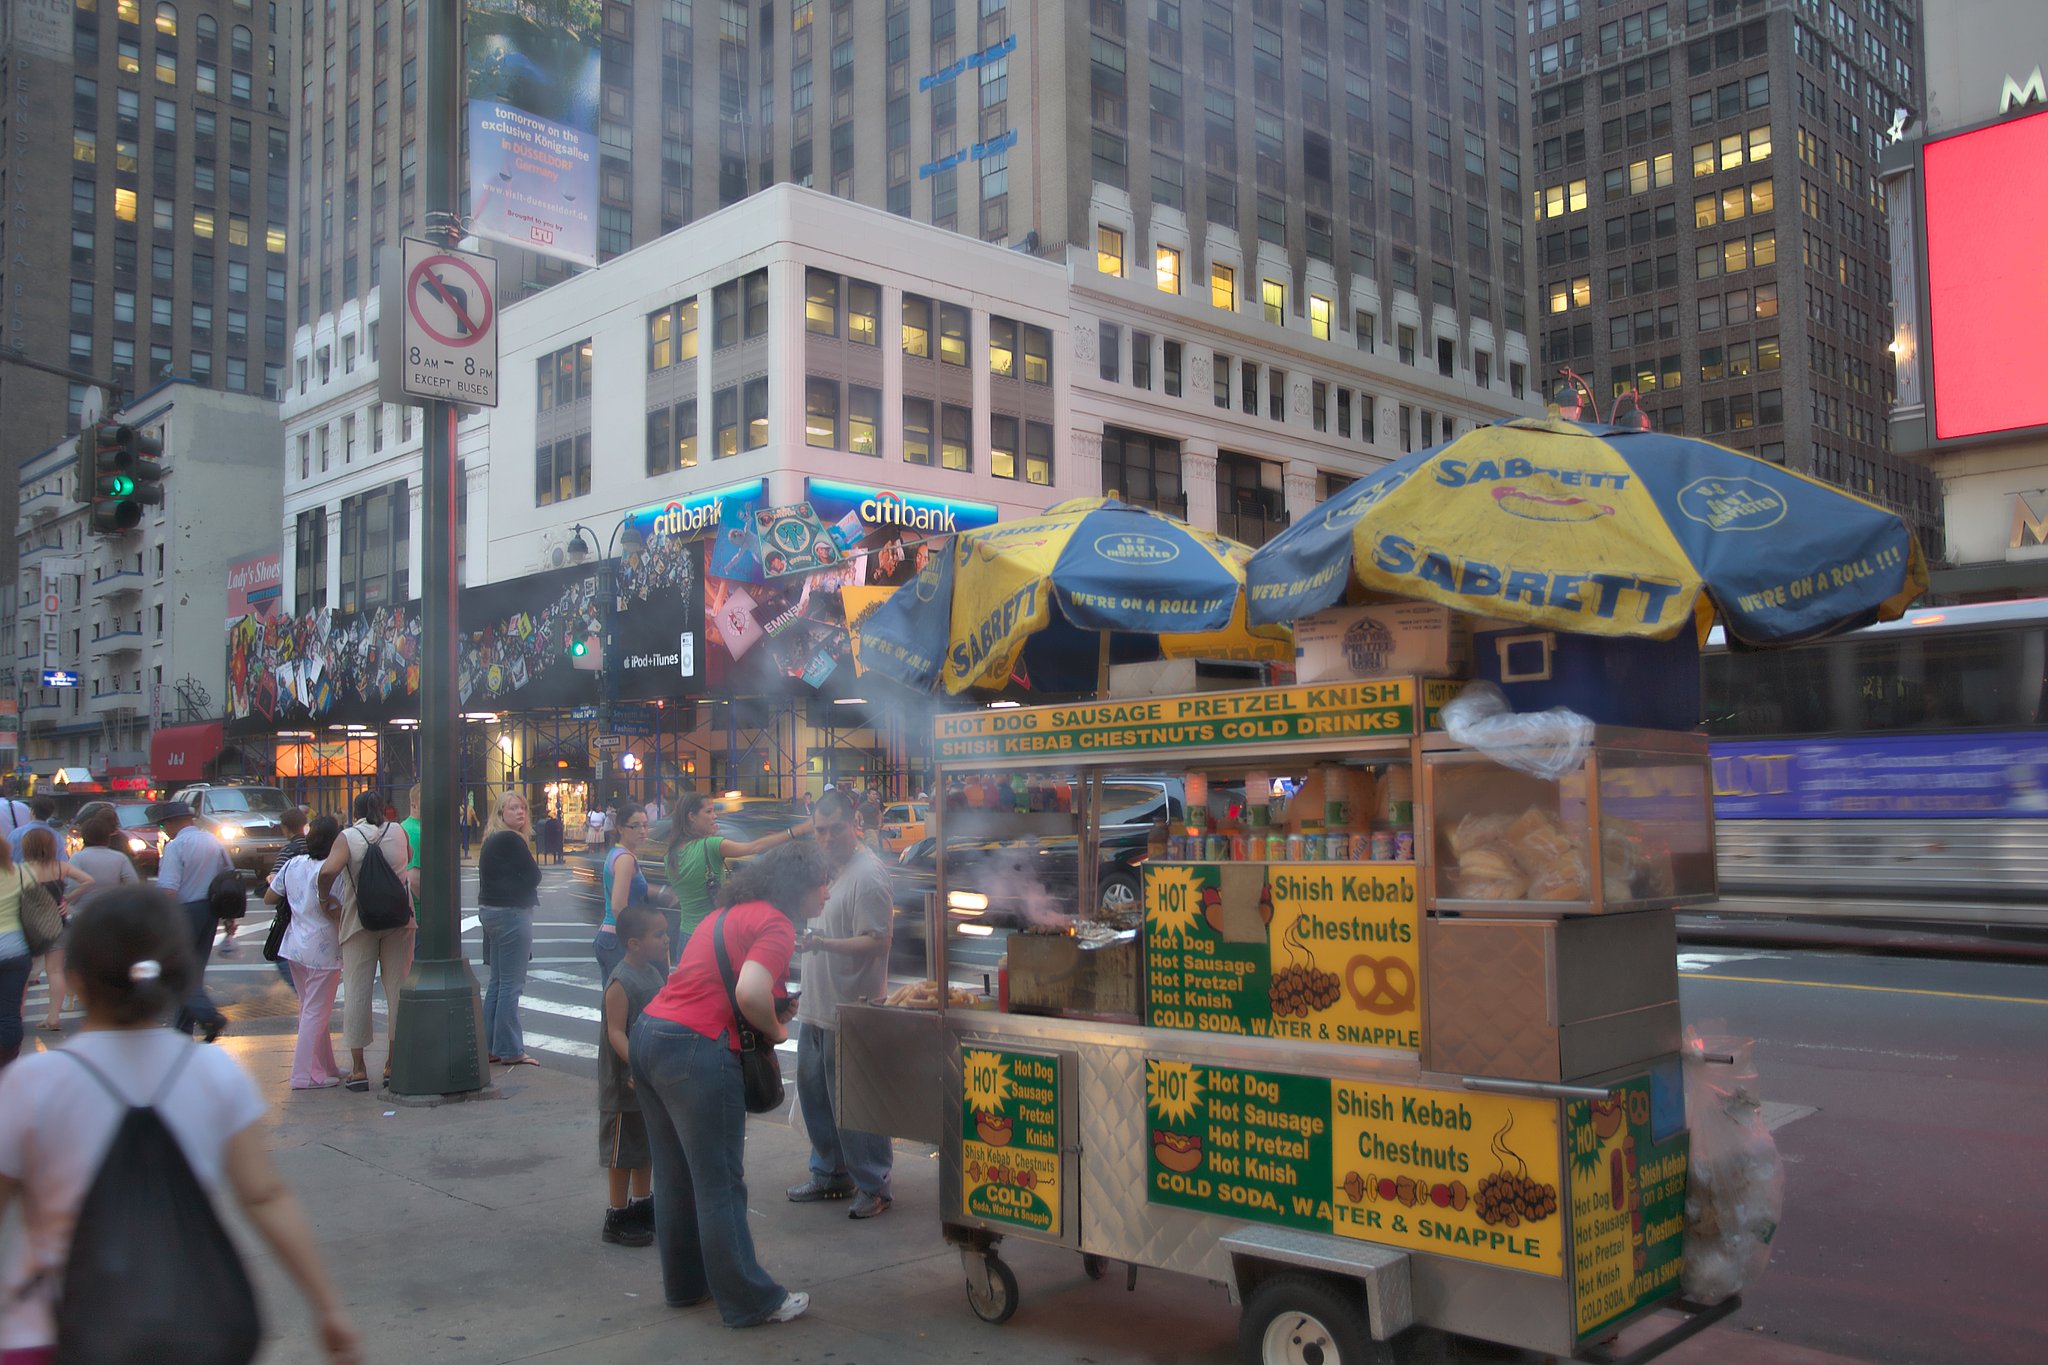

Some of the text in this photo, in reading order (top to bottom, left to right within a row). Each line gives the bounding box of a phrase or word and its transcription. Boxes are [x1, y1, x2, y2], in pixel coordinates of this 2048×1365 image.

[481, 119, 590, 161] exclusive Königsallee
[495, 107, 579, 144] tomorrow on the
[14, 58, 30, 266] PENNSYLVANIA
[513, 141, 574, 172] DÜSSELDORF
[515, 158, 559, 182] Germany
[507, 209, 535, 223] Brought
[535, 216, 542, 225] to
[531, 226, 554, 245] LTU
[409, 346, 421, 366] 8
[423, 358, 439, 369] AM
[464, 356, 475, 376] 8
[479, 368, 493, 380] PM
[414, 373, 489, 396] EXCEPT BUSES
[1430, 456, 1631, 491] SABRETT
[653, 496, 724, 537] citibank
[860, 493, 956, 533] citibank
[1707, 497, 1779, 527] INSPECTED
[1106, 550, 1171, 559] INSPECTED
[227, 560, 281, 593] Lady's Shoes
[1251, 582, 1288, 600] WE'RE
[1371, 529, 1682, 625] SABRETT
[1736, 546, 1902, 615] WE'RE ON A ROLL !!!
[1071, 590, 1223, 614] WE'RE ON A ROLL !!!
[43, 576, 59, 669] HOTEL
[950, 577, 1041, 679] SABRETT
[862, 634, 893, 655] WE'RE
[630, 652, 679, 668] iPod+iTunes
[1429, 683, 1446, 702] HOT
[944, 684, 1400, 735] HOT DOG SAUSAGE PRETZEL KNISH
[614, 724, 637, 733] Fashion
[941, 712, 1401, 757] SHISH KEBAB CHESTNUTS COLD DRINKS
[167, 751, 186, 766] J&J
[1158, 884, 1188, 913] HOT
[1274, 875, 1415, 904] Shish Kebab
[1297, 913, 1412, 943] Chestnuts
[1150, 934, 1215, 955] Hot Dog
[1150, 952, 1256, 975] Hot Sausage
[1151, 970, 1244, 992] Hot Pretzel
[1151, 989, 1232, 1010] Hot Knish
[1153, 1009, 1420, 1048] COLD SODA, WATER & SNAPPLE
[973, 1066, 997, 1094] HOT
[1014, 1059, 1054, 1084] Hot Dog
[1157, 1070, 1188, 1102] HOT
[1207, 1070, 1280, 1101] Hot Dog
[1011, 1082, 1054, 1106] Sausage
[1019, 1104, 1055, 1125] Pretzel
[1207, 1099, 1324, 1136] Hot Sausage
[1336, 1088, 1473, 1132] Shish Kebab
[1025, 1127, 1055, 1148] Knish
[1208, 1125, 1310, 1160] Hot Pretzel
[1357, 1130, 1470, 1173] Chestnuts
[1576, 1124, 1598, 1154] HOT
[964, 1144, 1055, 1173] Shish Kebab Chestnuts
[1208, 1151, 1297, 1185] Hot Knish
[1639, 1152, 1687, 1190] Shish Kebab
[986, 1185, 1033, 1209] COLD
[1574, 1191, 1610, 1218] Hot Dog
[1643, 1177, 1686, 1207] on a stick
[972, 1199, 1050, 1226] Soda, Water & Snapple
[1156, 1171, 1542, 1258] COLD SODA, WATER & SNAPPLE
[1576, 1210, 1631, 1247] Hot Sausage
[1645, 1212, 1685, 1248] Chestnuts
[1577, 1238, 1626, 1274] Hot Pretzel
[1578, 1265, 1620, 1299] Hot Knish
[1581, 1299, 1603, 1325] COLD
[1604, 1289, 1626, 1311] SODA,
[1627, 1270, 1653, 1298] WATER
